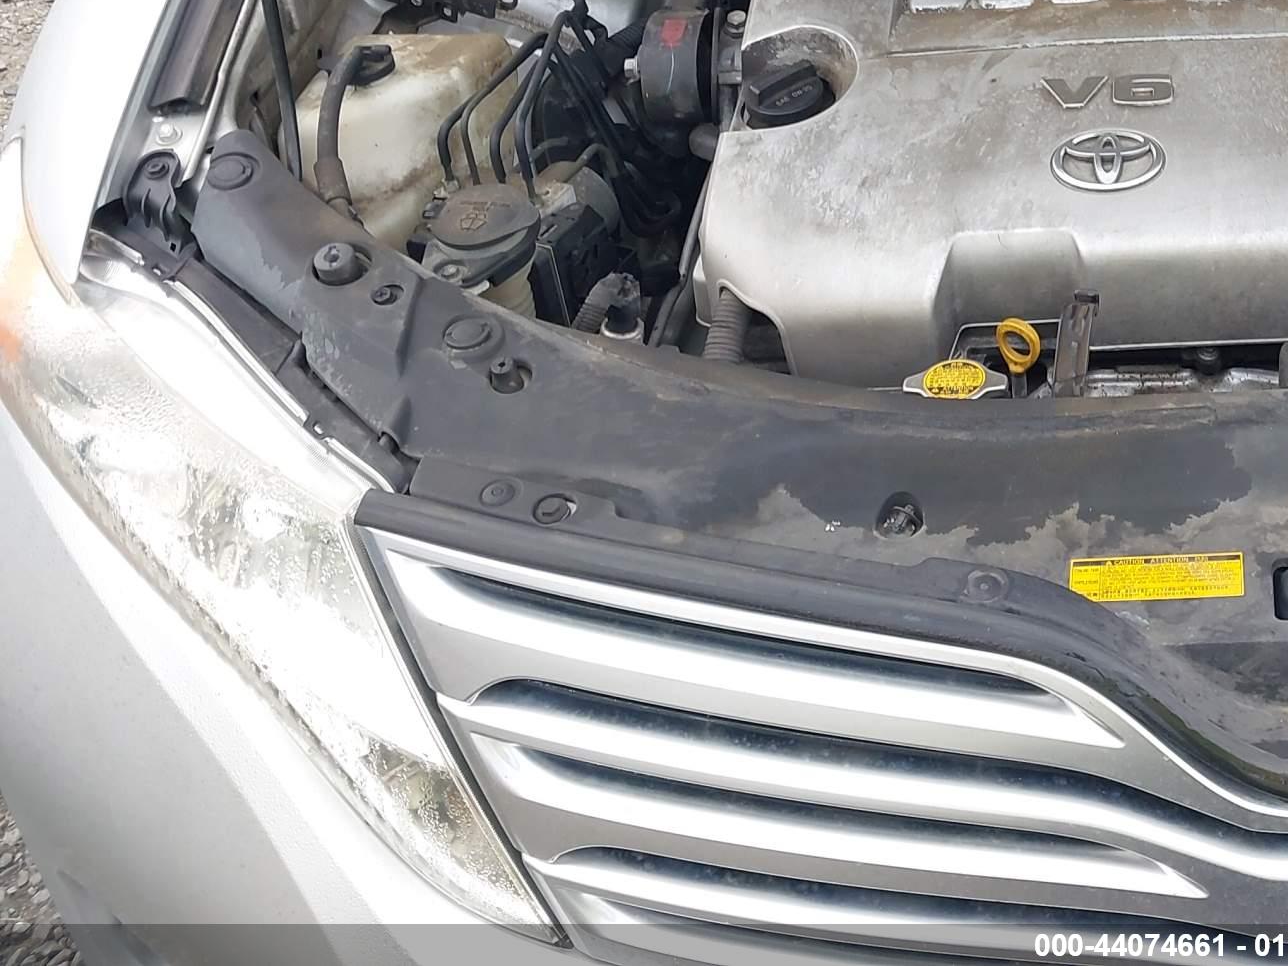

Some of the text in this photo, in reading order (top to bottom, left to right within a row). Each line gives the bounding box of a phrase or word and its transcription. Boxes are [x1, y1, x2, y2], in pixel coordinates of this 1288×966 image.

[1040, 73, 1174, 108] V6
[1113, 558, 1145, 566] CAUTION
[1150, 556, 1189, 564] ATTENTION
